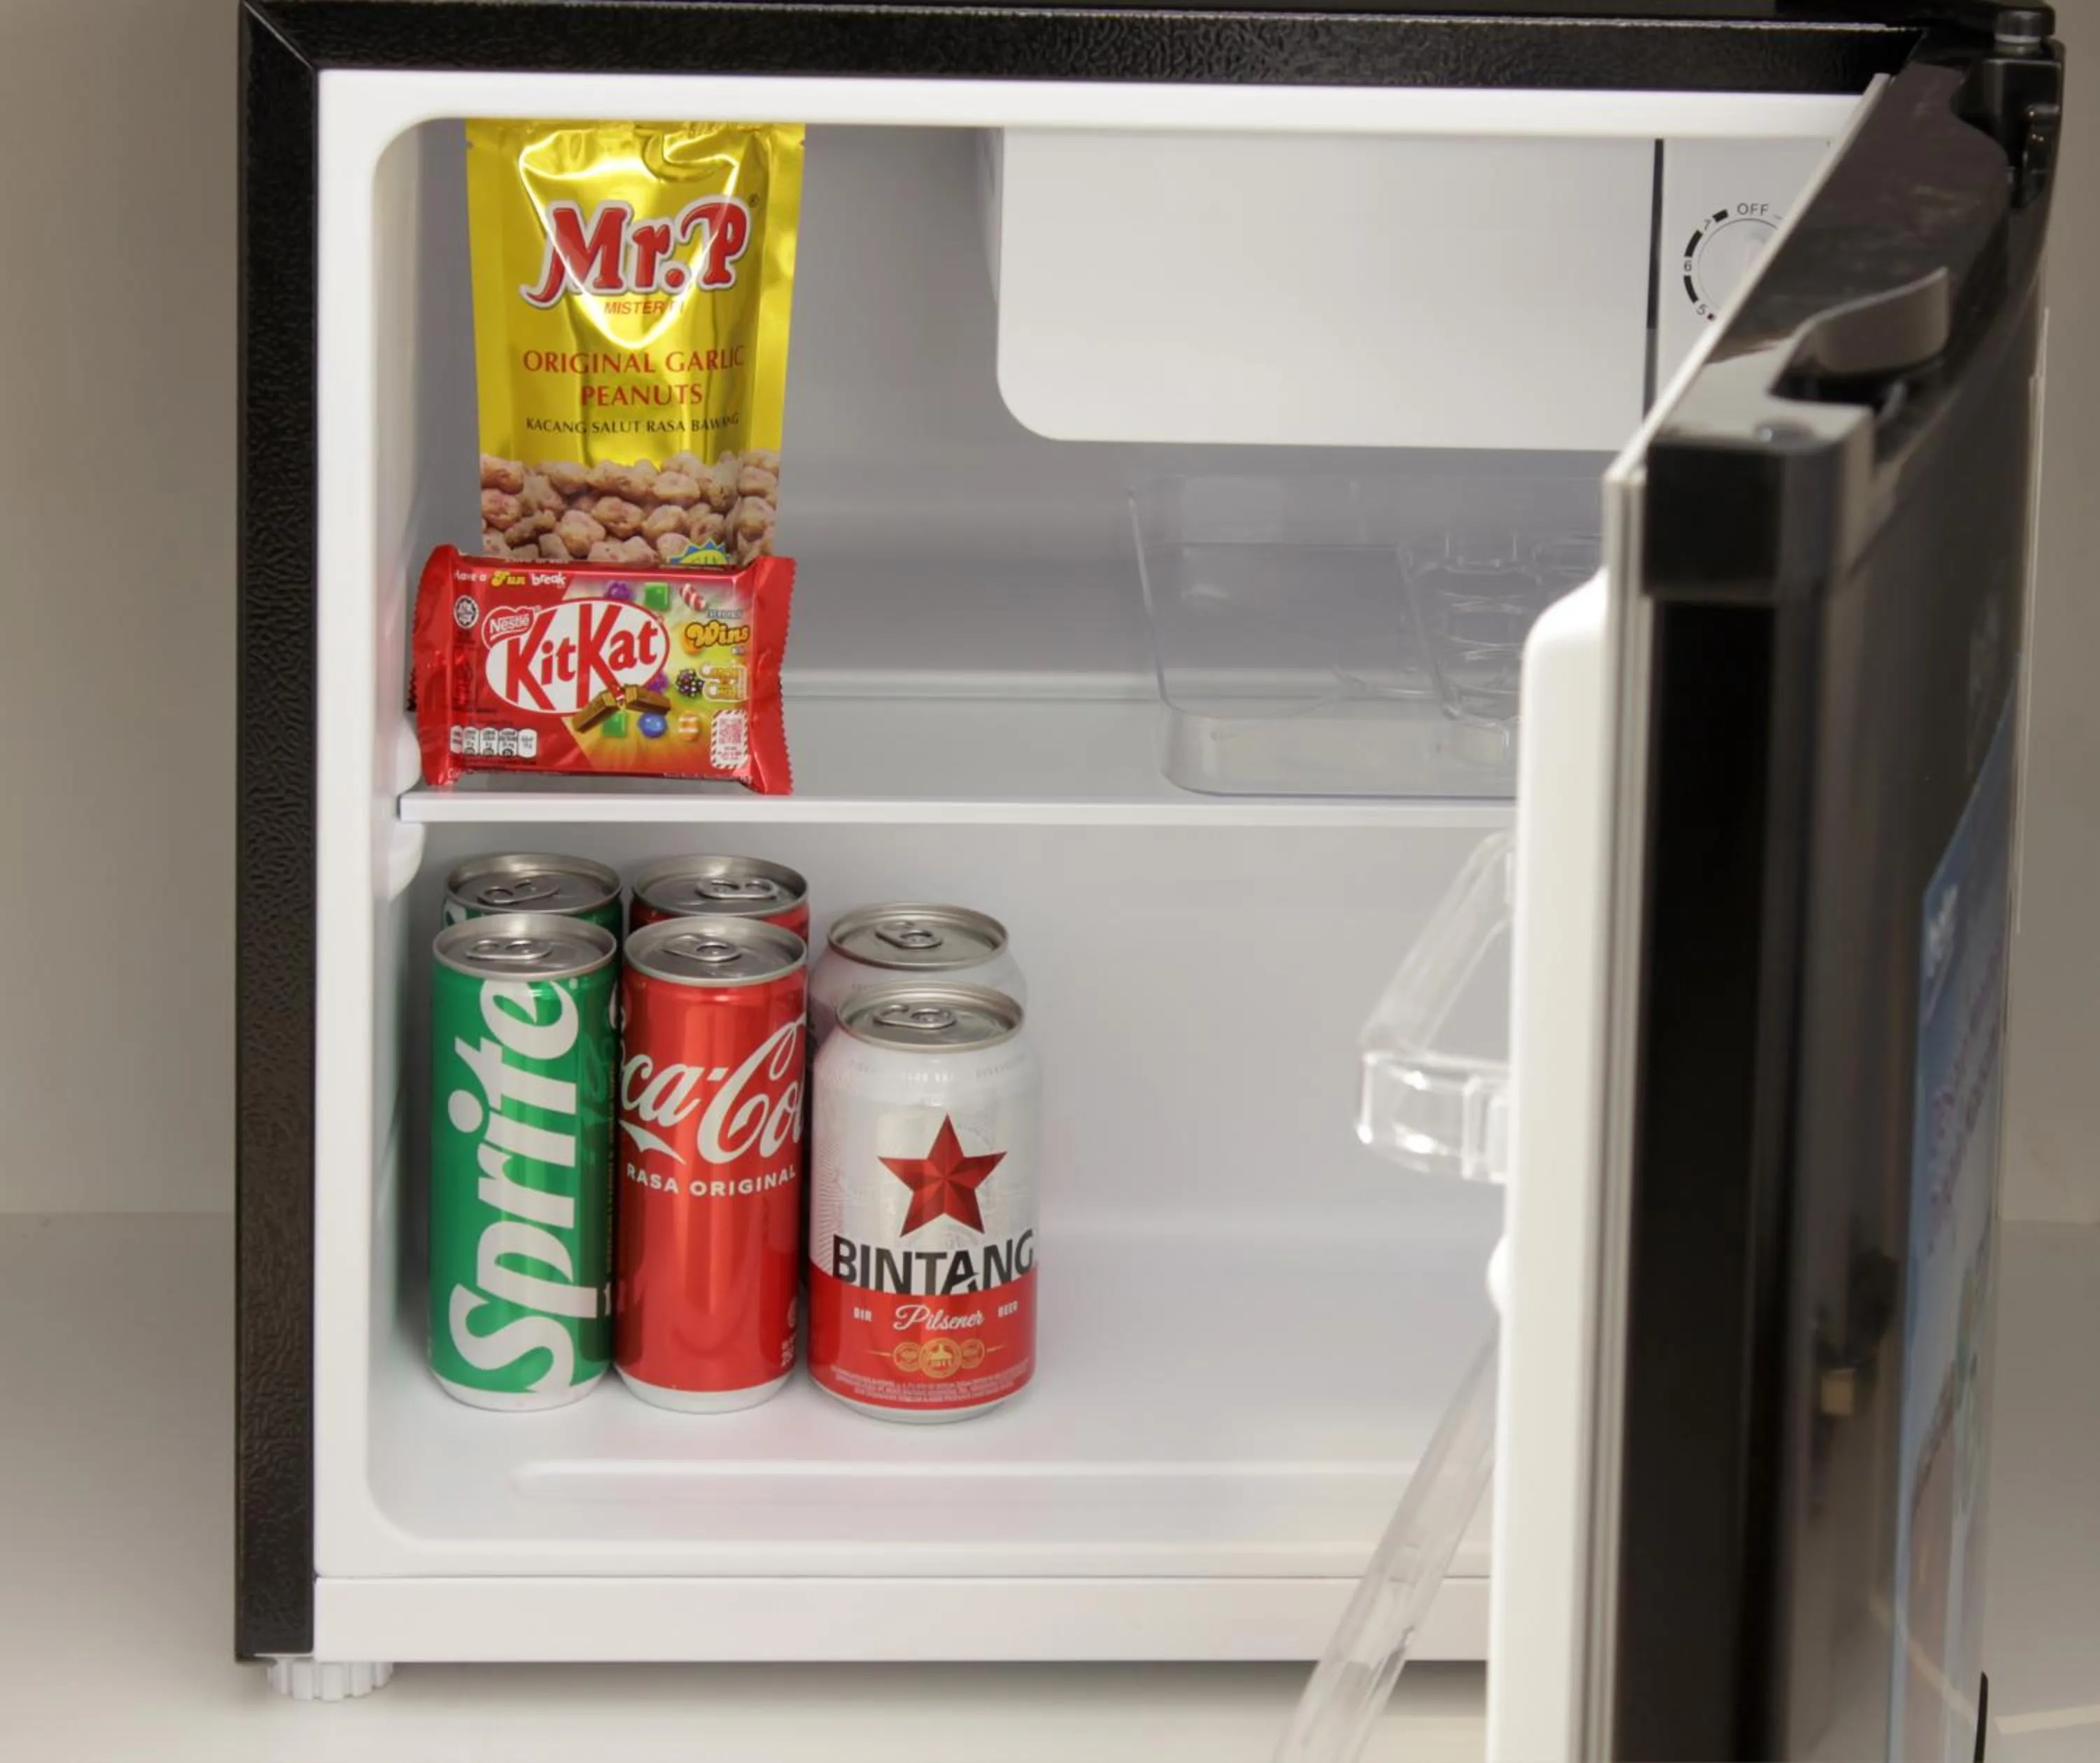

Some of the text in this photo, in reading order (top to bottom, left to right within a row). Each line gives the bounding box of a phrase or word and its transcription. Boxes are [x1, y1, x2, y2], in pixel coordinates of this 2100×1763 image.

[1737, 203, 1769, 216] OFF
[1703, 218, 1712, 231] 7
[1684, 259, 1692, 272] 6
[604, 301, 665, 314] MISTER
[1695, 303, 1708, 316] 5
[523, 345, 746, 375] ORIGINAL GARLIC
[580, 383, 703, 407] PEANUTS
[526, 417, 587, 434] KACANG
[592, 420, 640, 433] SALUT
[646, 419, 685, 432] RASA
[531, 572, 566, 588] break
[685, 619, 750, 649] Wins
[505, 602, 659, 711] KitKat
[447, 980, 596, 1393] Sprite
[627, 1163, 796, 1197] RASA ORIGINAL
[832, 1229, 1033, 1296] BINTANG
[892, 1304, 984, 1330] Pilsener
[997, 1300, 1018, 1318] BEER
